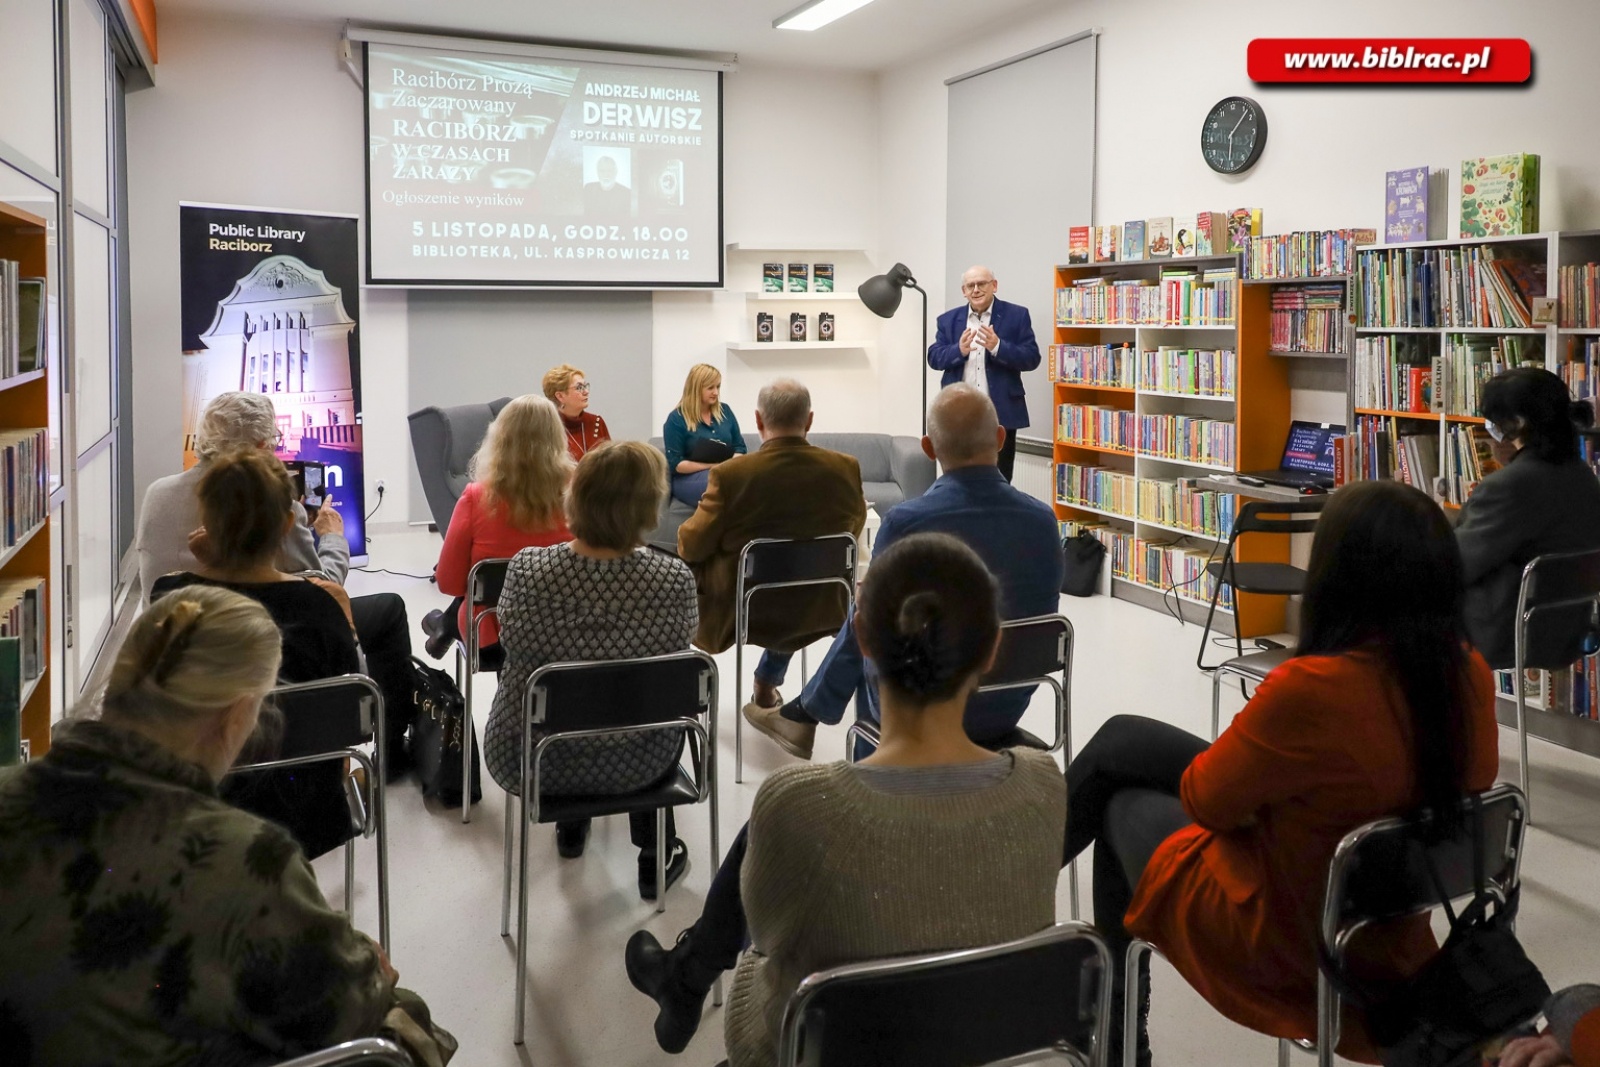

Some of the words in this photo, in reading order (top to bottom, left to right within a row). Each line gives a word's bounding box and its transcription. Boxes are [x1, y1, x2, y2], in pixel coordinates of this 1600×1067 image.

[392, 67, 477, 91] Racibórz
[481, 74, 534, 99] Prozą
[585, 82, 648, 99] ANDRZEJ
[650, 87, 701, 102] MICHAŁ
[392, 88, 517, 117] Zaczarowany
[583, 101, 702, 130] DERWISZ
[392, 118, 517, 142] RACIBÓRZ
[570, 129, 635, 143] SPOTKANIE
[639, 133, 702, 146] AUTORSKIE
[393, 143, 412, 159] W
[417, 144, 511, 162] CZASACH
[393, 163, 476, 181] ZARAZY
[382, 190, 460, 207] Ogłoszenie
[464, 193, 525, 208] wyników
[209, 223, 255, 237] Public
[257, 226, 306, 243] Library
[412, 221, 424, 237] 5
[431, 221, 557, 242] LISTOPADA,
[564, 224, 626, 241] GODZ.
[632, 225, 689, 242] 18.00
[209, 238, 273, 253] Raciborz
[412, 244, 518, 260] BIBLIOTEKA,
[524, 246, 548, 258] UL.
[554, 247, 670, 260] KASPROWICZA
[675, 248, 690, 260] 12
[1434, 359, 1442, 399] ROŚLINY
